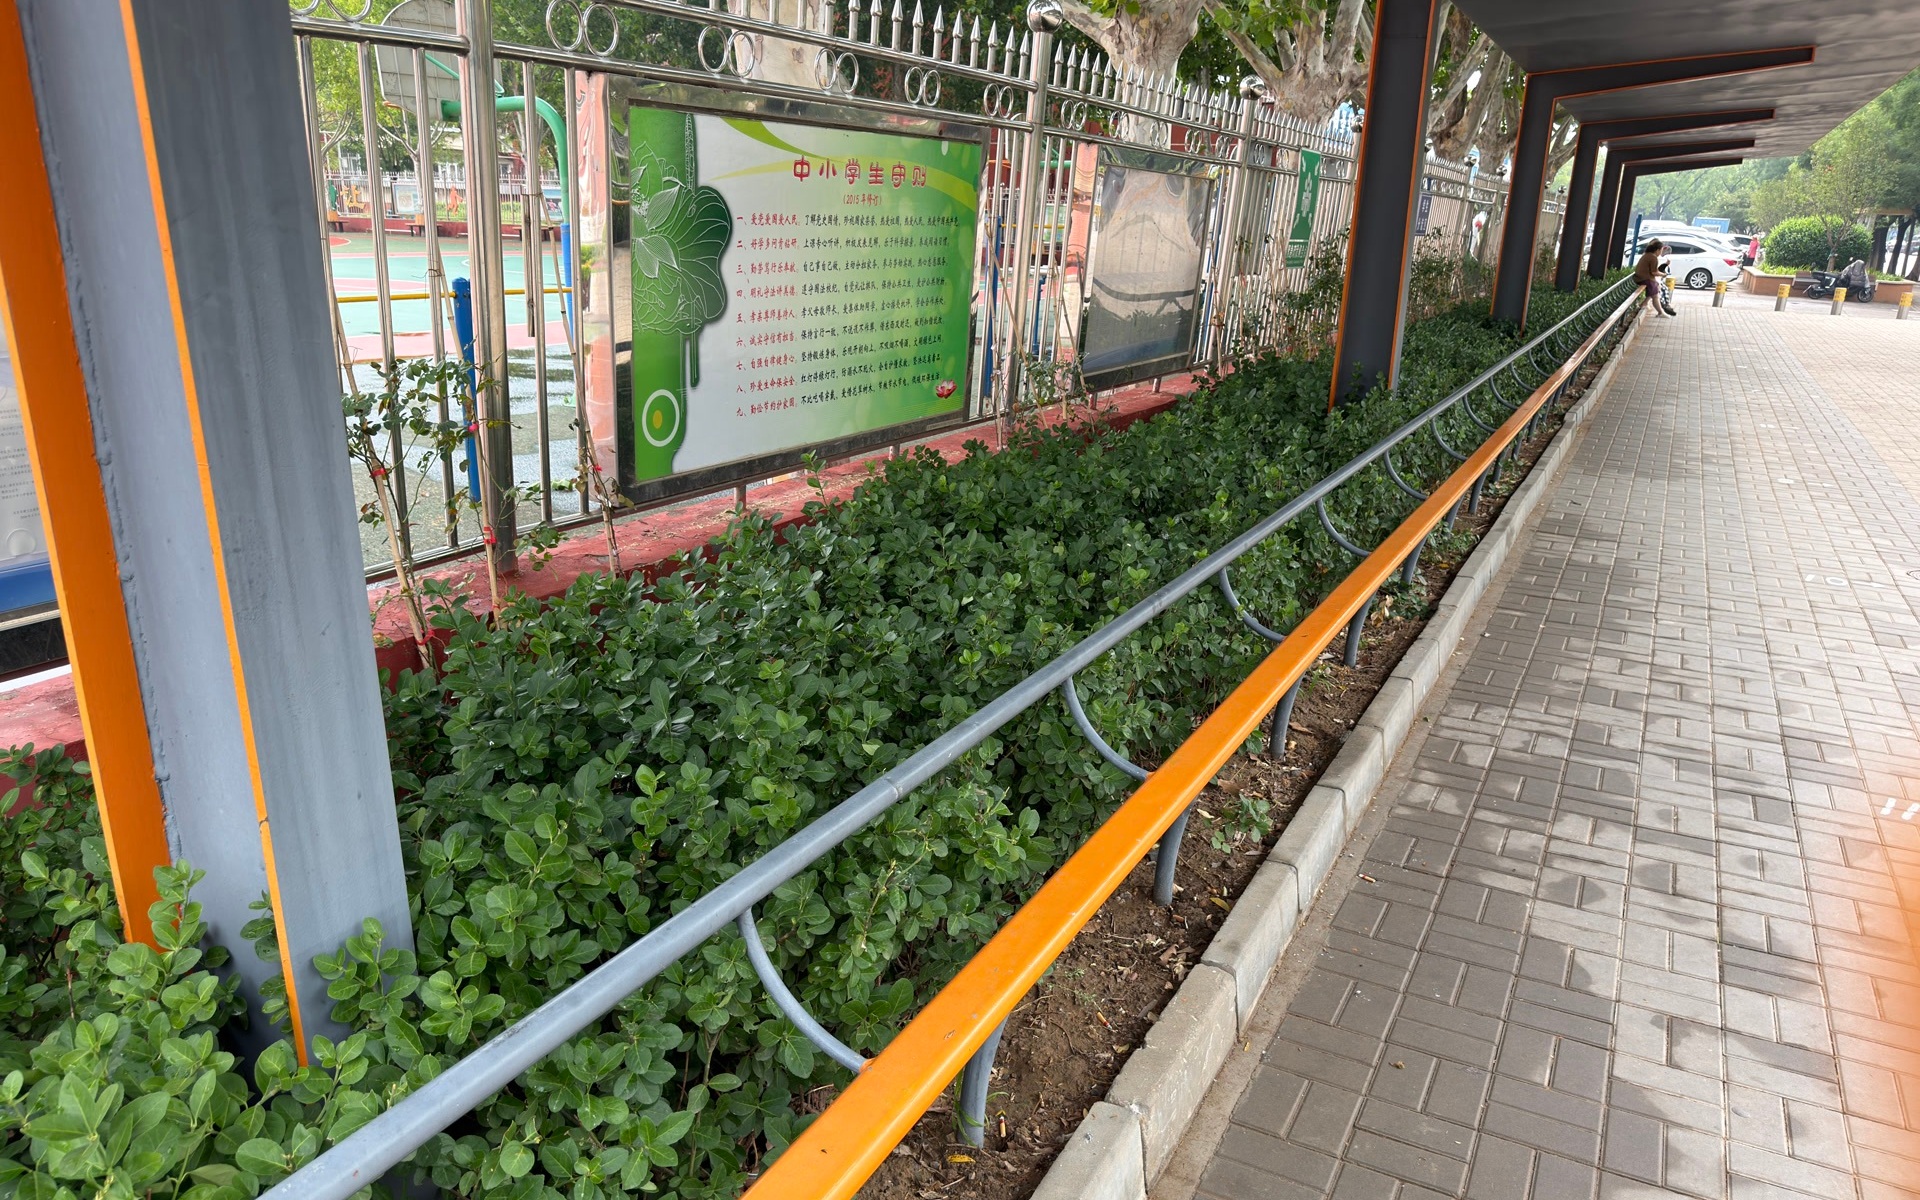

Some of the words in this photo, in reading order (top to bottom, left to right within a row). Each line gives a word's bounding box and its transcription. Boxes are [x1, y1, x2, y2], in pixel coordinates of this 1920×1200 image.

[793, 154, 927, 188] 中小学生守则
